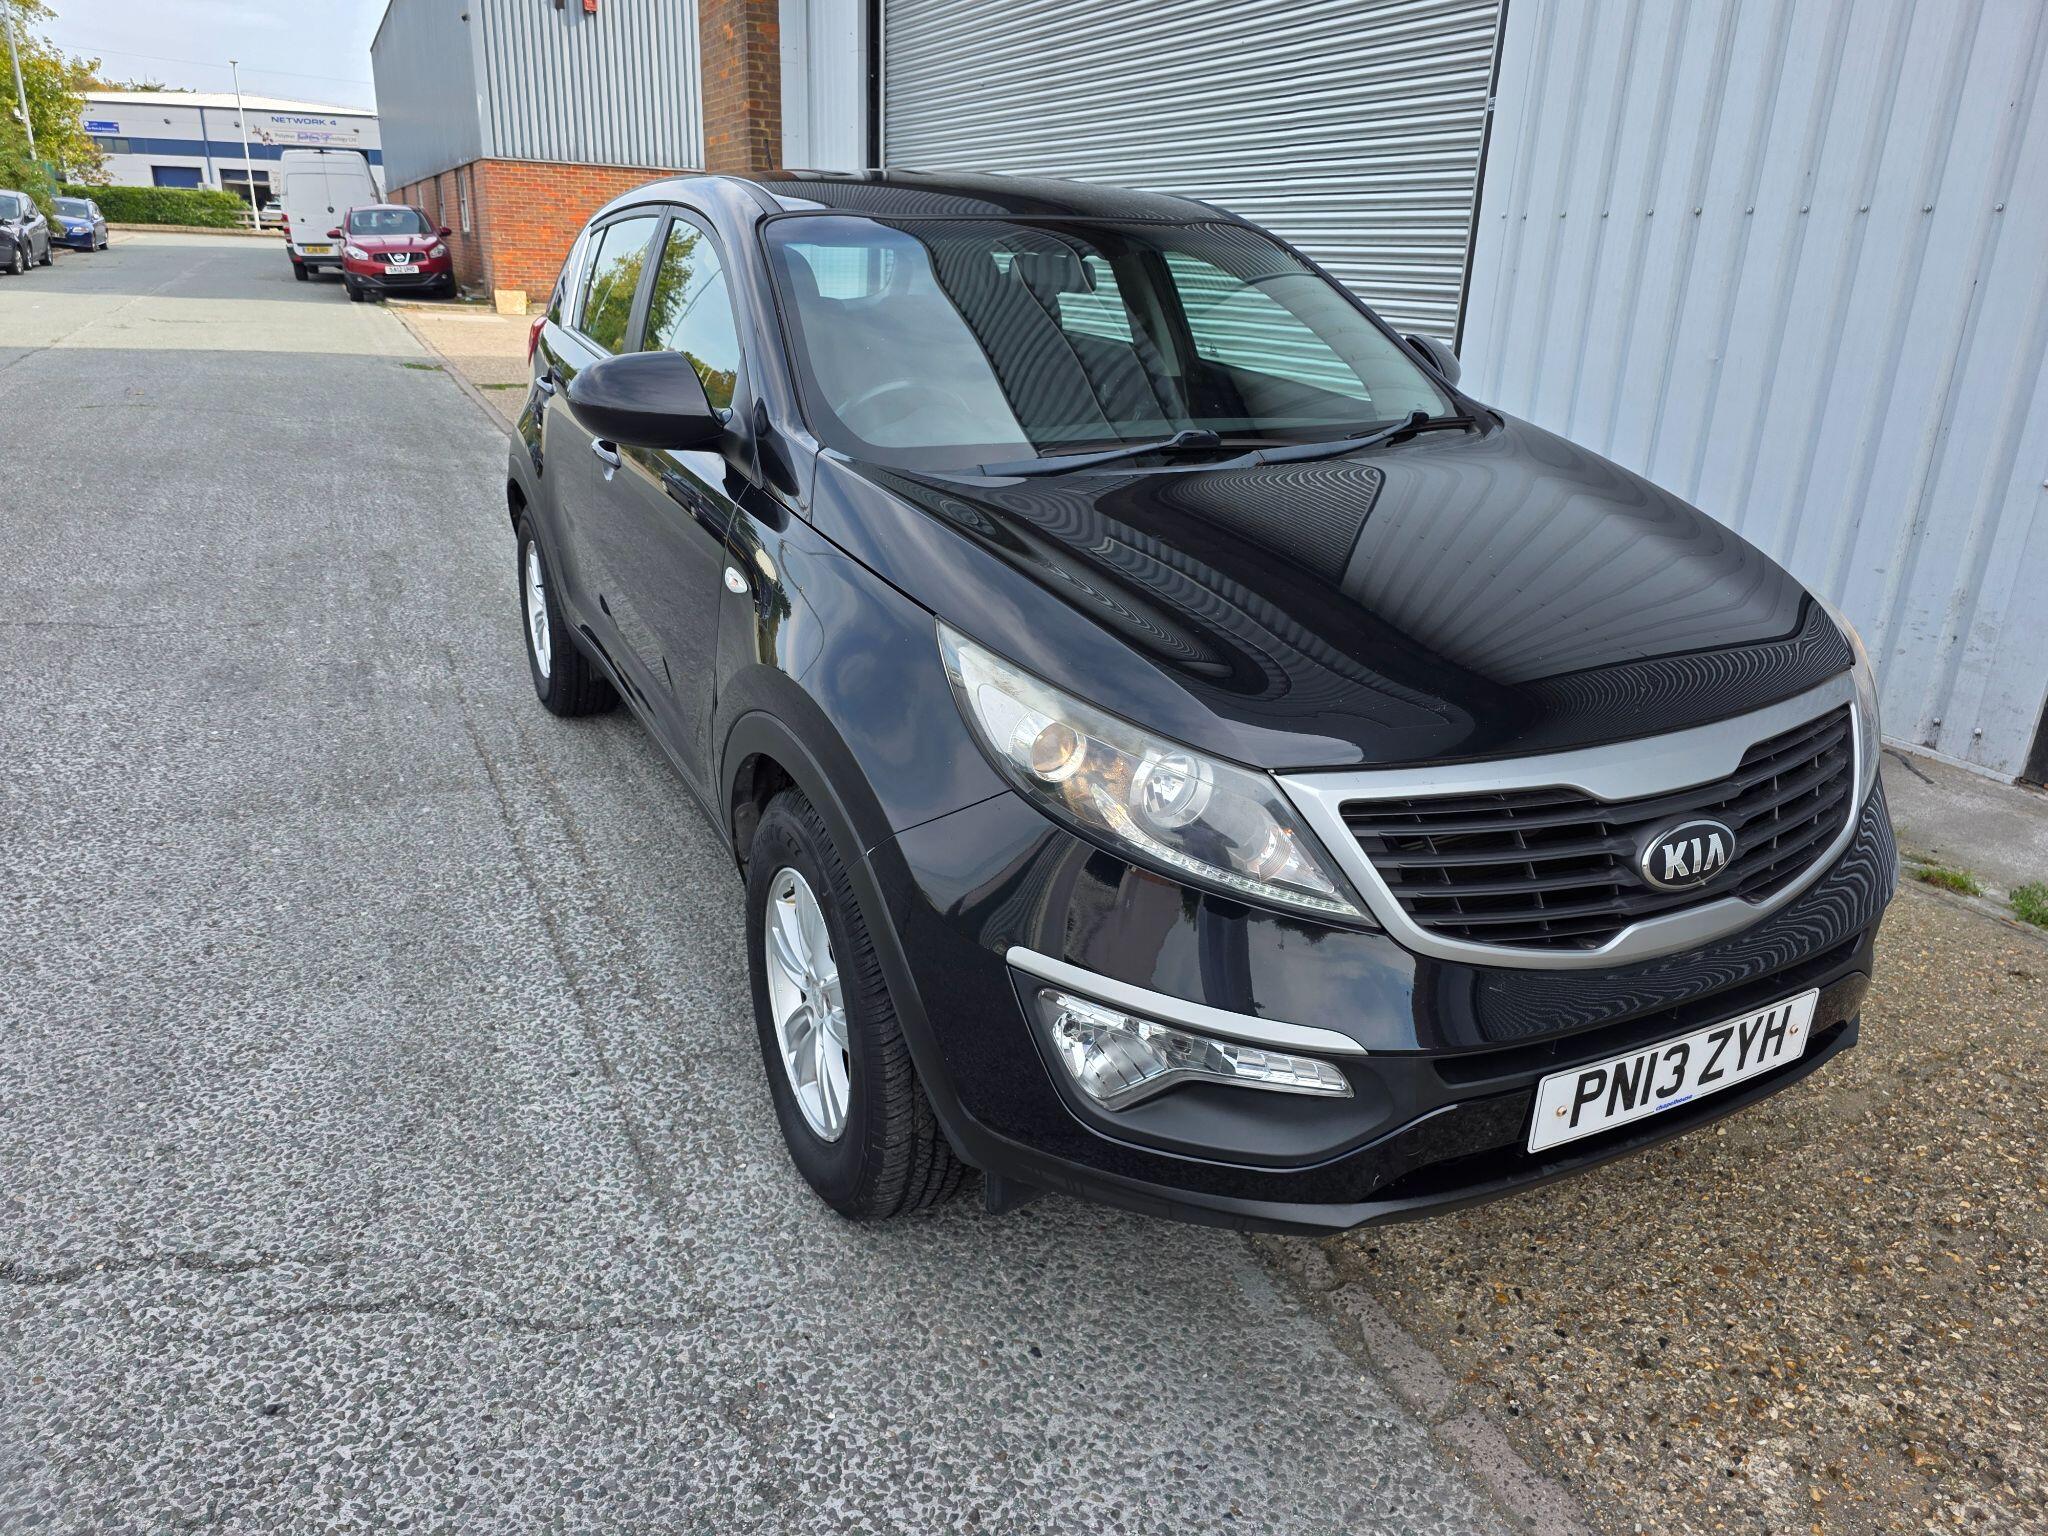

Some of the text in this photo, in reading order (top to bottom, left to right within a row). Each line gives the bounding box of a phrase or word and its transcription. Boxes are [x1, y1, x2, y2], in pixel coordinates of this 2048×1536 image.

[271, 116, 327, 126] NETWORK
[1662, 833, 1725, 880] KIA
[1569, 1005, 1792, 1128] PN13 ZYH
